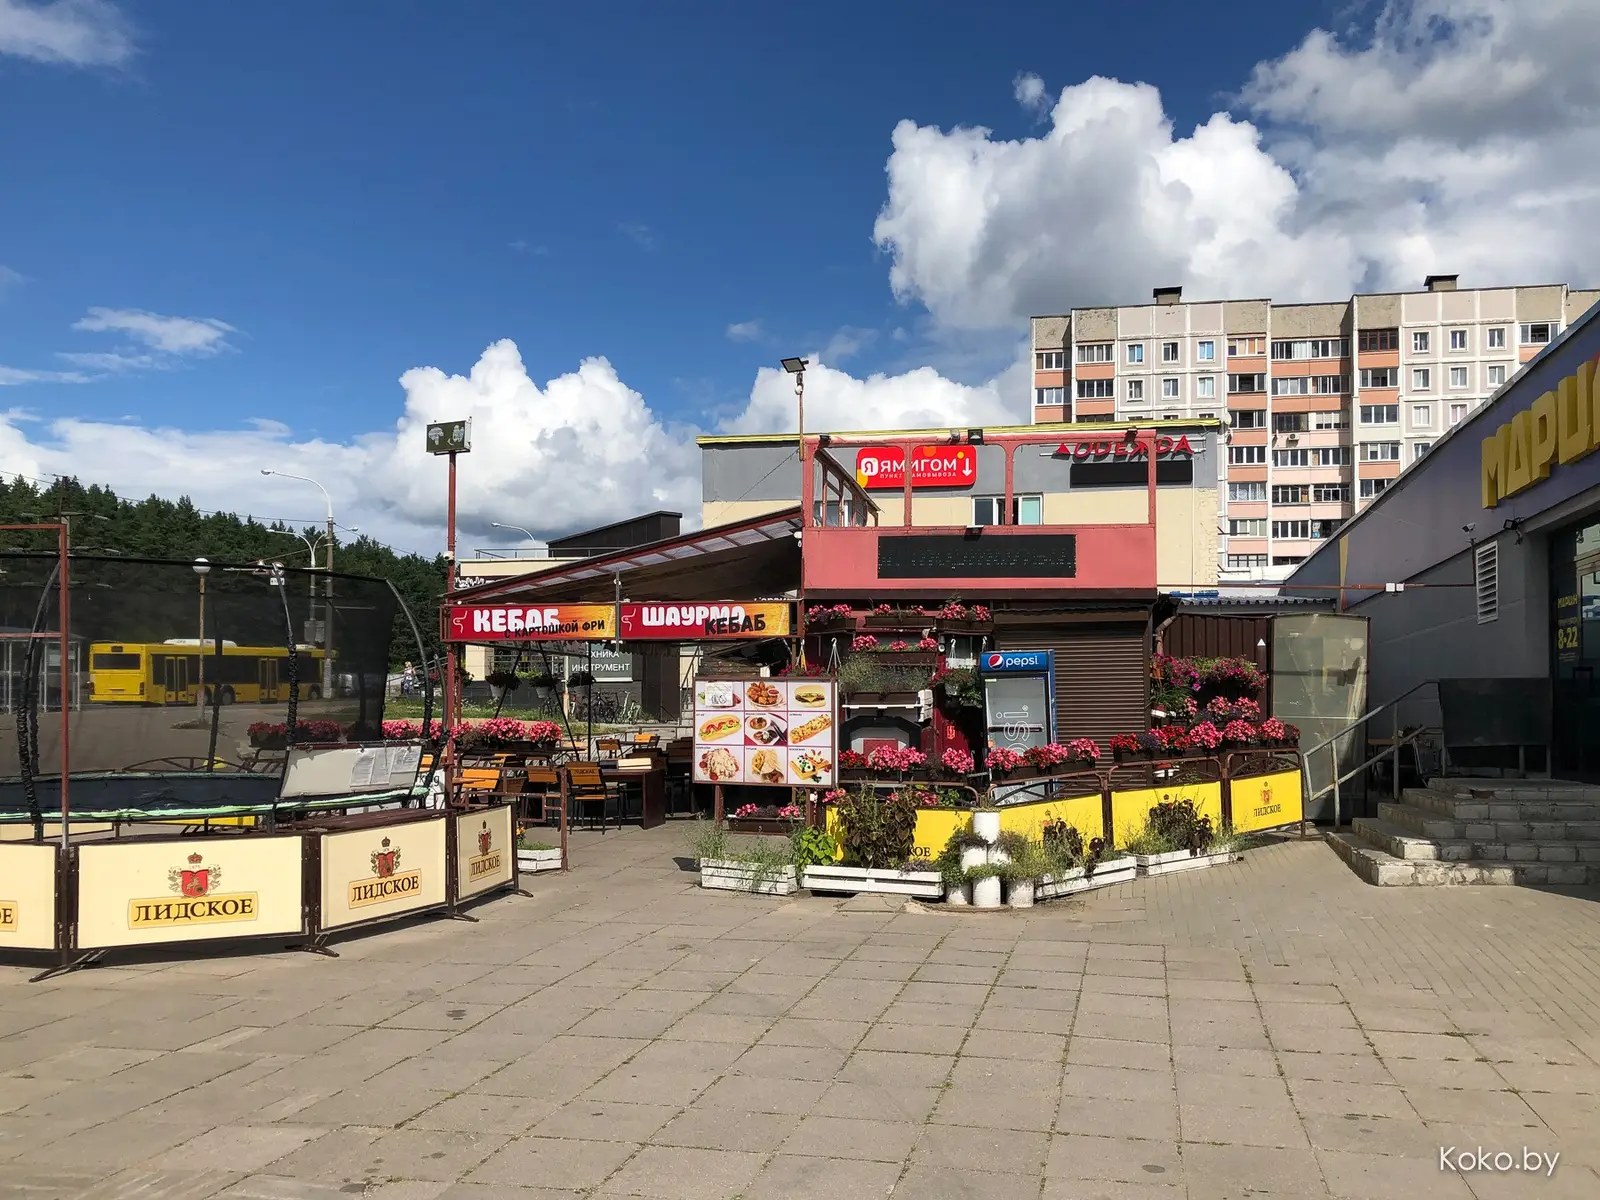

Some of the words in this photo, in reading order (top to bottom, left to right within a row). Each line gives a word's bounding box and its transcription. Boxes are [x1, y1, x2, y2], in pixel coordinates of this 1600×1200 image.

[1481, 355, 1600, 509] МАРЦ
[473, 608, 560, 633] КЕБАБ
[641, 605, 746, 626] ШАУРМА
[704, 613, 767, 636] КЕБАБ
[504, 629, 512, 639] С
[514, 620, 579, 638] КАРТОШКОЙ
[581, 619, 606, 632] ФРИ
[571, 663, 630, 672] ИНСТРУМЕНТ
[1005, 655, 1039, 668] pepsi
[1253, 803, 1282, 817] ЛИДСКОЕ
[470, 854, 500, 877] ЛИДСКОЕ
[351, 875, 420, 902] ЛИДСКОЕ
[133, 898, 254, 923] ЛИДСКОЕ
